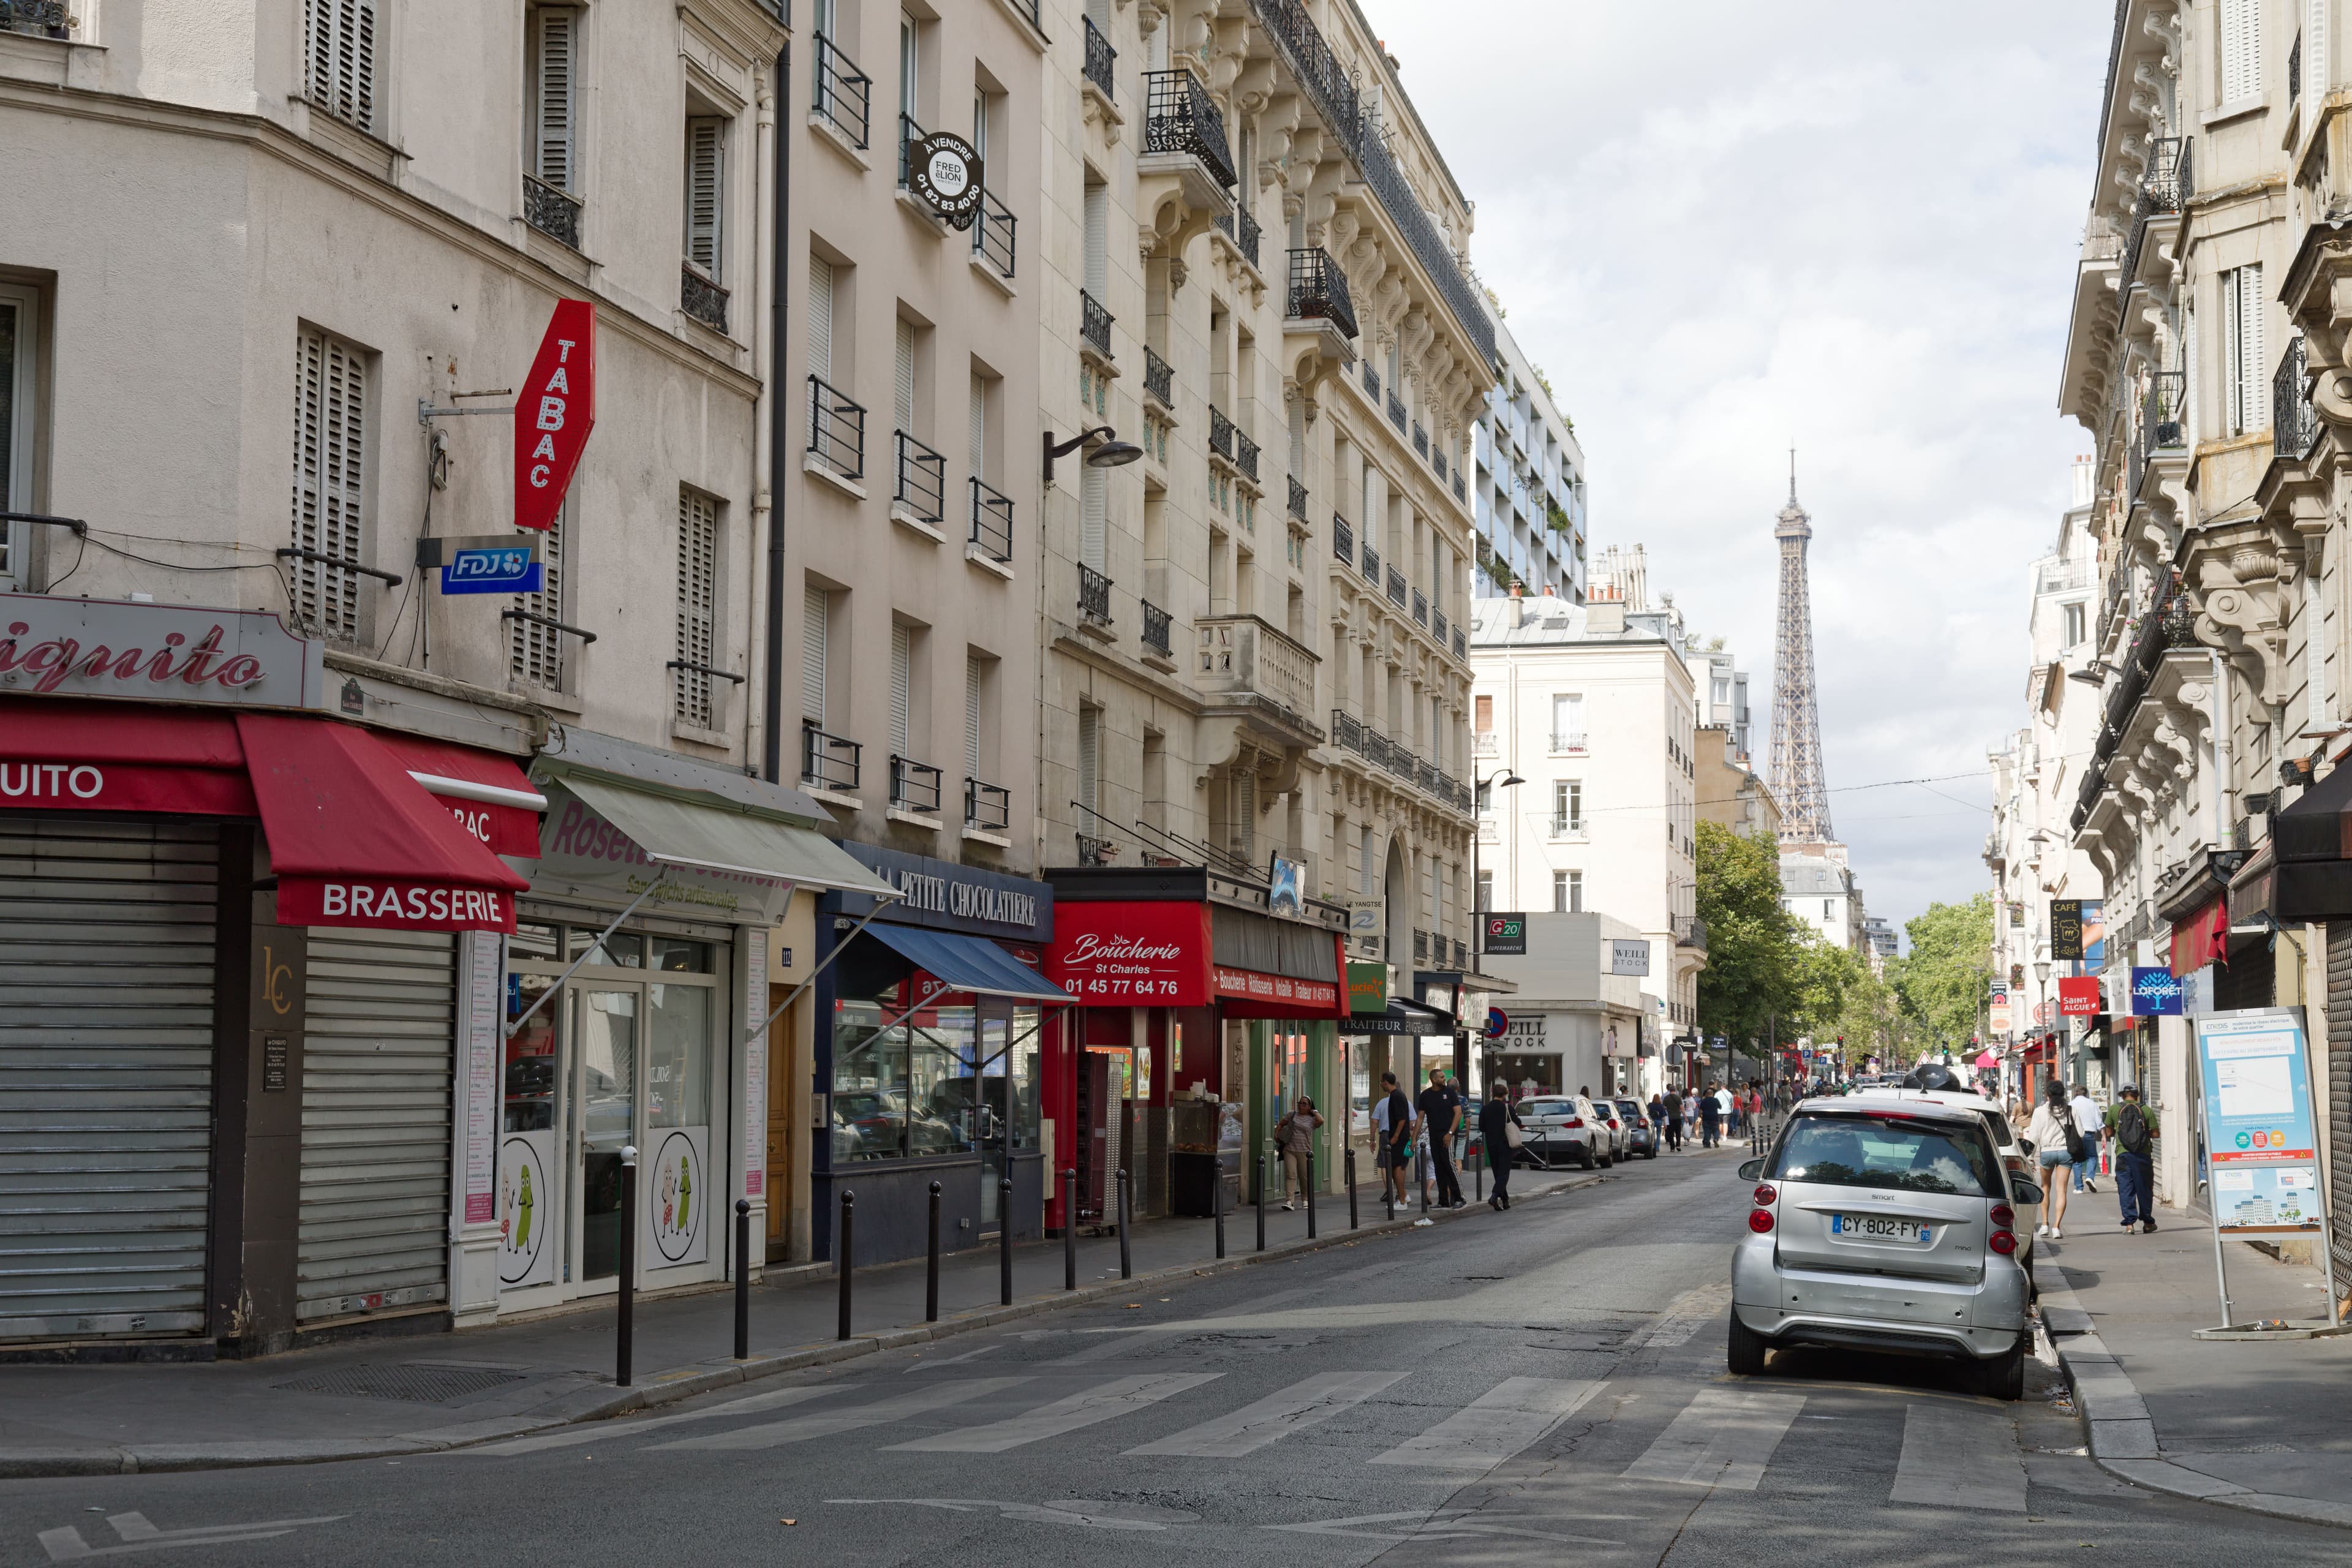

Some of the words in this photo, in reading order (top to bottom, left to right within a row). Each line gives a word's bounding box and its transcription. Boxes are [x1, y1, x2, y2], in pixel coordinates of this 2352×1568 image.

[932, 138, 973, 162] VENDRE
[935, 160, 961, 173] FRED
[917, 173, 929, 189] 01
[925, 189, 939, 205] 82
[941, 200, 955, 211] 83
[957, 197, 971, 211] 40
[968, 184, 980, 200] 00
[530, 339, 576, 488] TABAC
[456, 554, 501, 576] FDJ
[323, 884, 503, 922] BRASSERIE
[900, 870, 945, 912] PETITE
[949, 881, 1036, 927] CHOCOLATIERE
[2054, 902, 2077, 912] CAFÉ
[1110, 933, 1131, 946] حلال
[1063, 933, 1182, 964] Boucherie
[1615, 949, 1648, 959] WEILL
[1095, 963, 1107, 974] St
[1110, 963, 1150, 974] Charles
[1065, 979, 1082, 993] 01
[1088, 979, 1107, 993] 45
[1112, 980, 1131, 994] 77
[1135, 980, 1154, 994] 64
[1159, 981, 1177, 995] 76
[1219, 970, 1245, 991] Boucherie
[1275, 978, 1292, 998] Volaille
[1295, 981, 1311, 1000] Traiteur
[1343, 1019, 1401, 1031] TRAITEUR
[1508, 1022, 1547, 1036] EILL
[1842, 1218, 1920, 1237] CY-802-FY
[1921, 1232, 1929, 1240] 75
